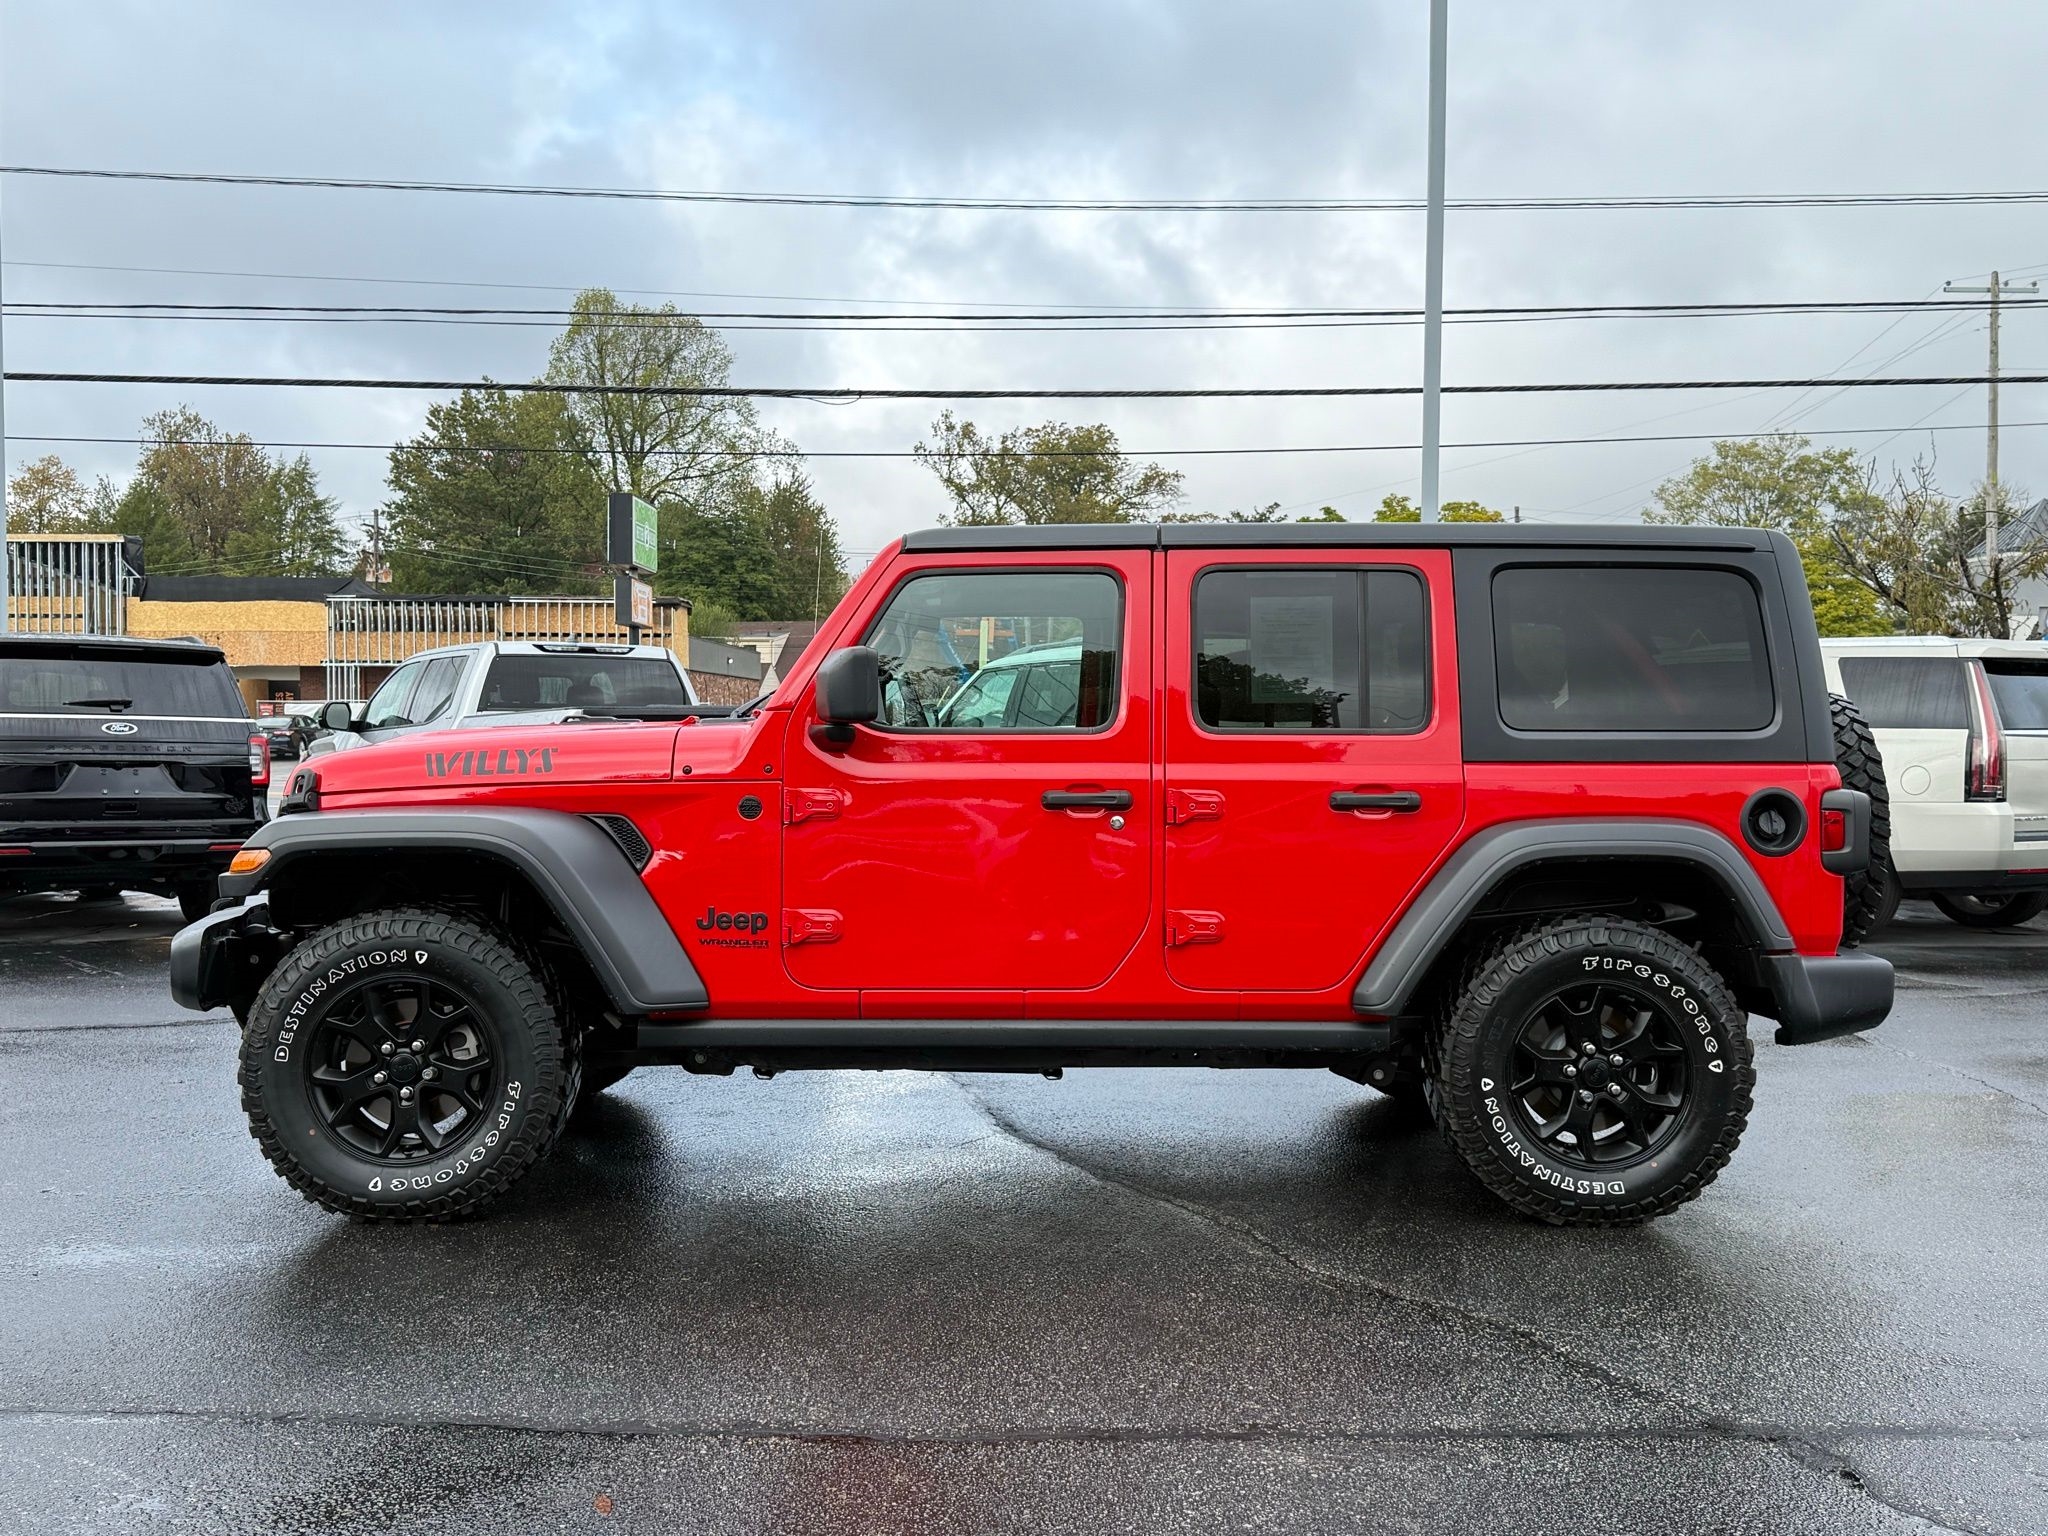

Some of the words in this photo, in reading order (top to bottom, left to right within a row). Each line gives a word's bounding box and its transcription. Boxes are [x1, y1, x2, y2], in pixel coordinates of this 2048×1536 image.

[425, 747, 559, 777] WILLYS
[696, 906, 769, 935] Jeep
[274, 949, 408, 1063] DESTINATION
[1484, 1096, 1626, 1196] DESTINATION
